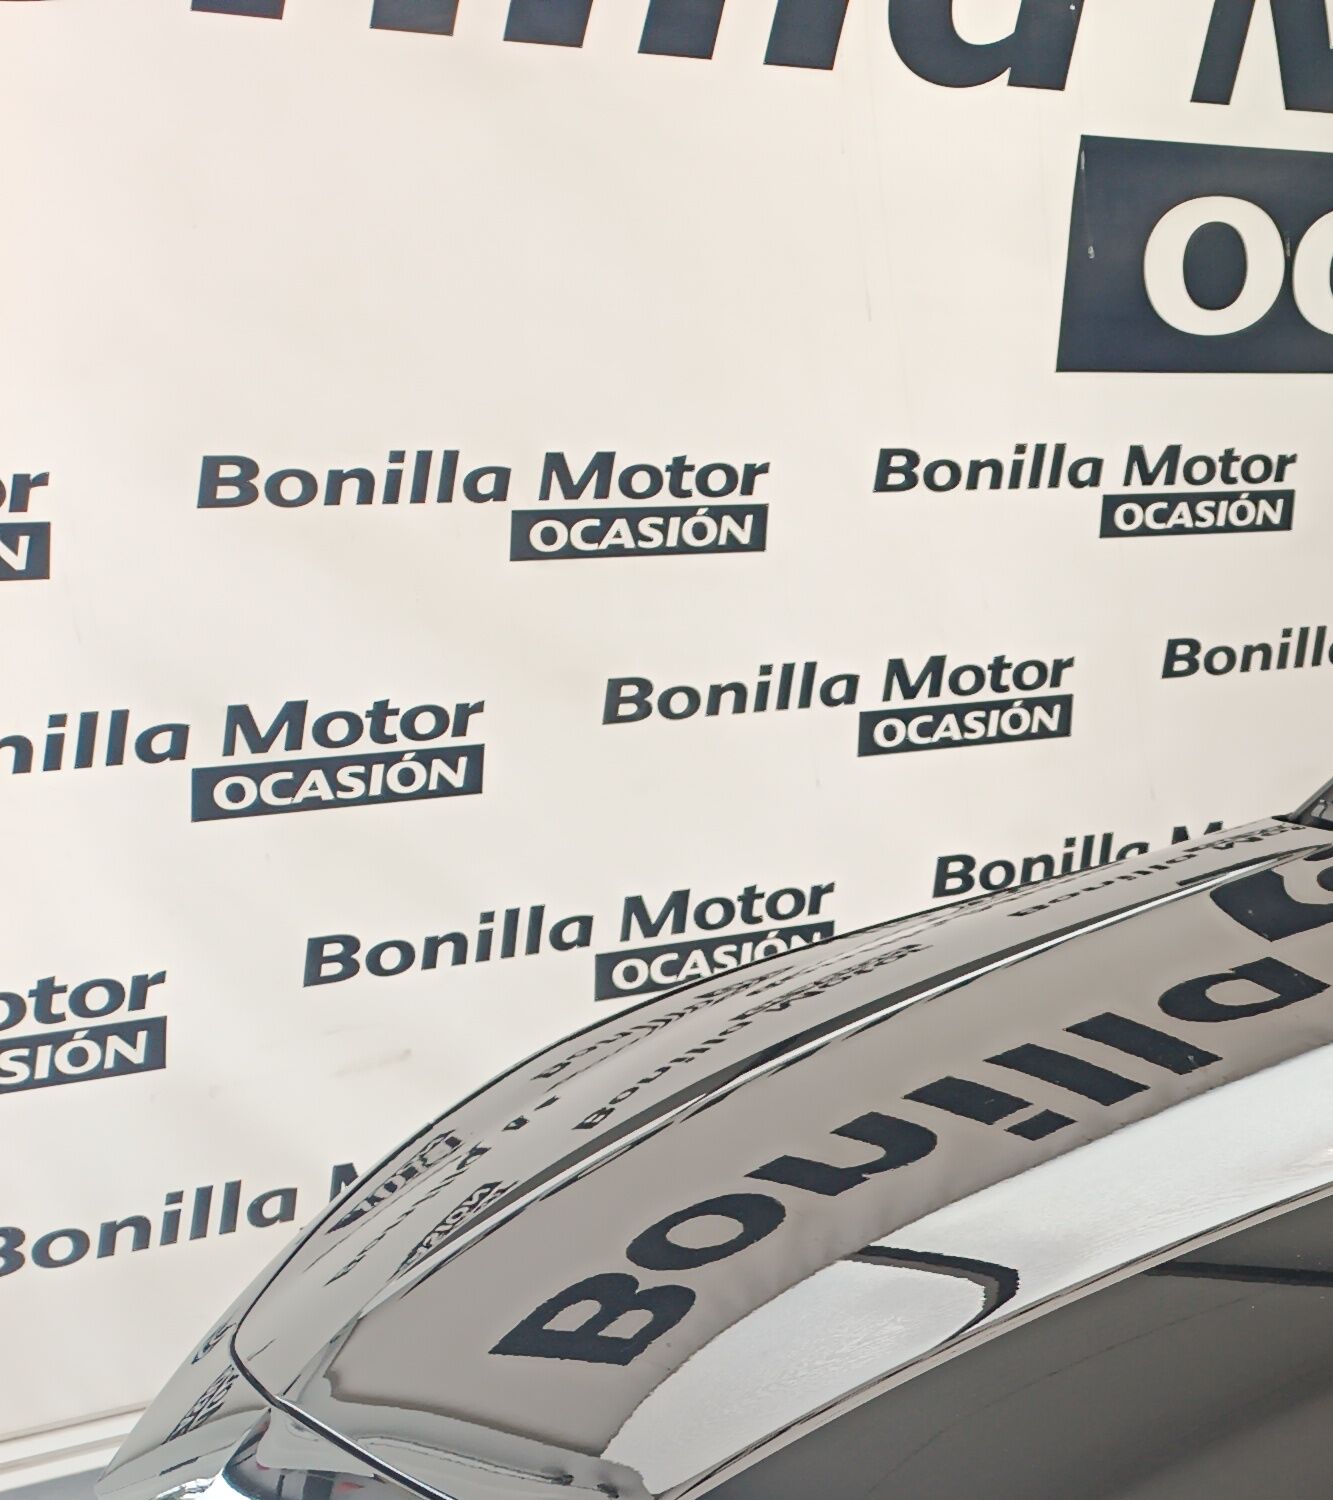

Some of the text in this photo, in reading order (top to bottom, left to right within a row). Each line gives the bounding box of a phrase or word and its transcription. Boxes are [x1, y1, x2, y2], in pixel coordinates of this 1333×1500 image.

[197, 450, 770, 508] Bonilla Motor
[873, 443, 1297, 492] Bonilla Motor
[529, 507, 754, 552] OCASIÓN
[1113, 498, 1283, 531] OCASIÓN
[602, 655, 1074, 725] Bonilla Motor
[223, 699, 484, 756] Motor
[873, 699, 1060, 747] OCASIÓN
[213, 751, 468, 811] OCASIÓN
[304, 882, 834, 987] Bonilla Motor
